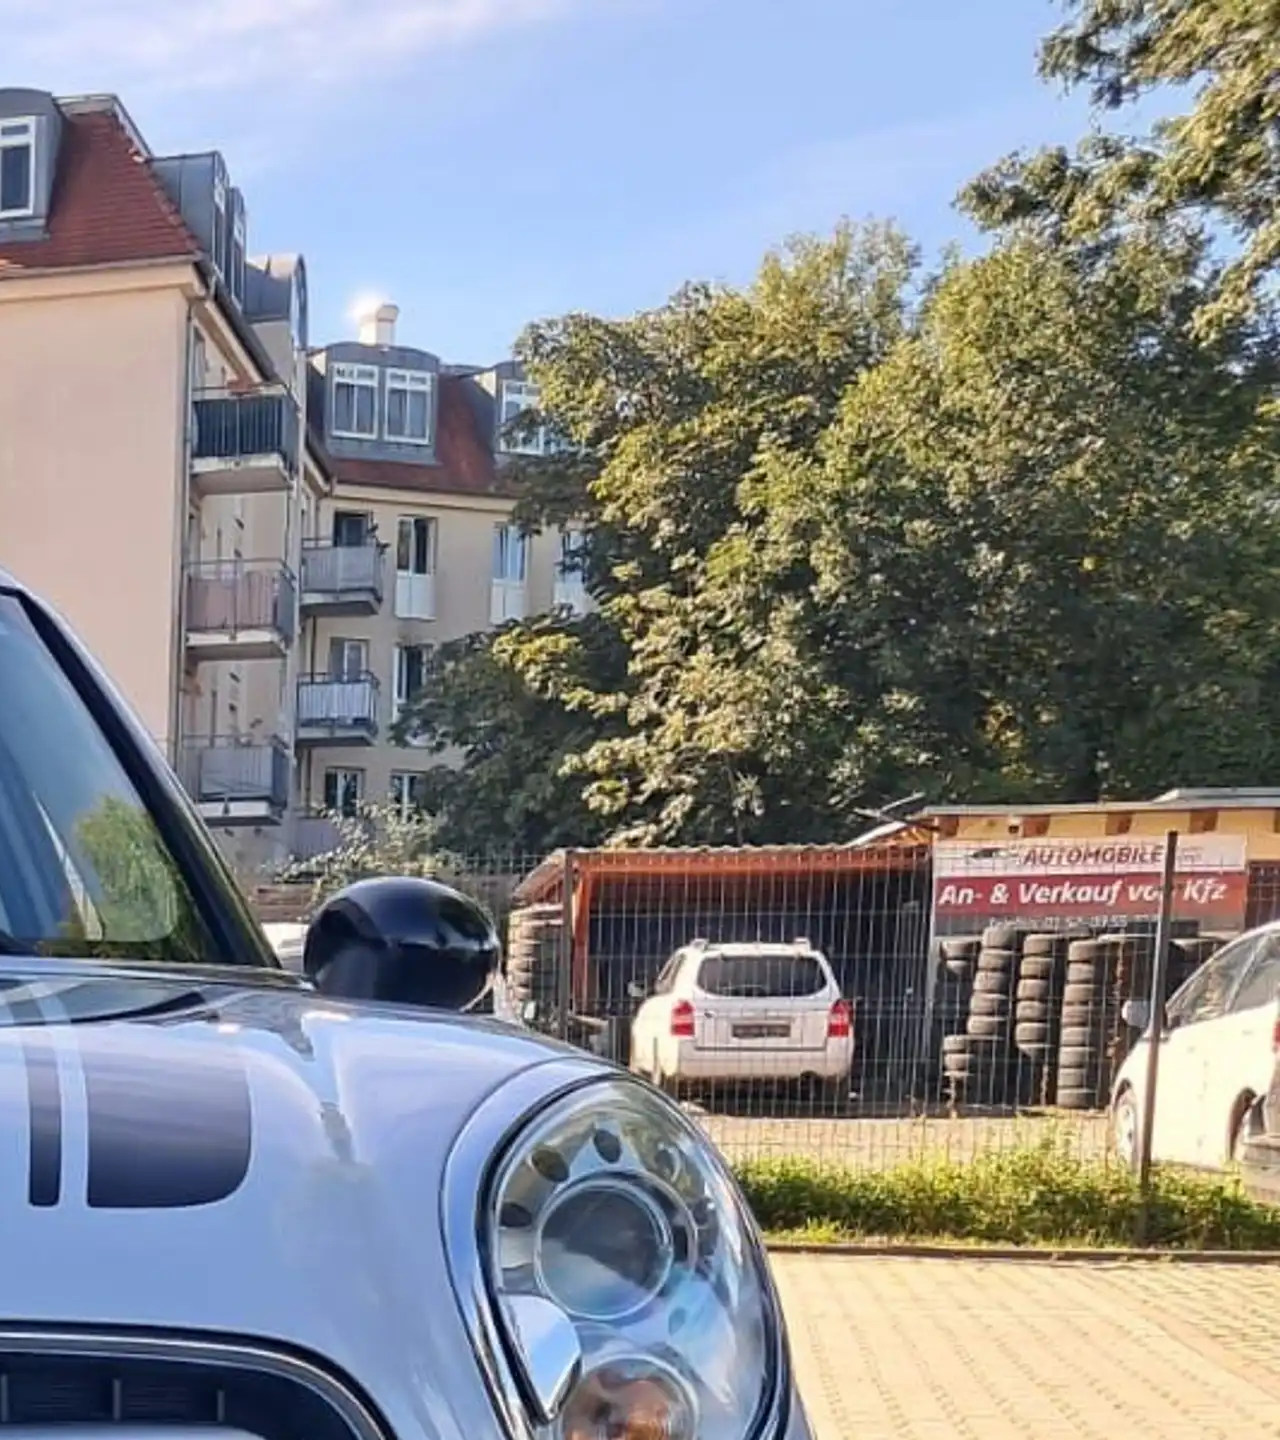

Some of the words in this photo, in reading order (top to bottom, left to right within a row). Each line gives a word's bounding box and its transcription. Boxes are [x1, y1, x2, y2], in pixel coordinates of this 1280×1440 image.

[1023, 844, 1164, 865] AUTOMOBILE
[940, 884, 984, 904] An-
[990, 883, 1010, 904] &
[1019, 880, 1123, 906] Verkauf
[1128, 885, 1176, 902] vo
[1182, 878, 1228, 904] Kfz
